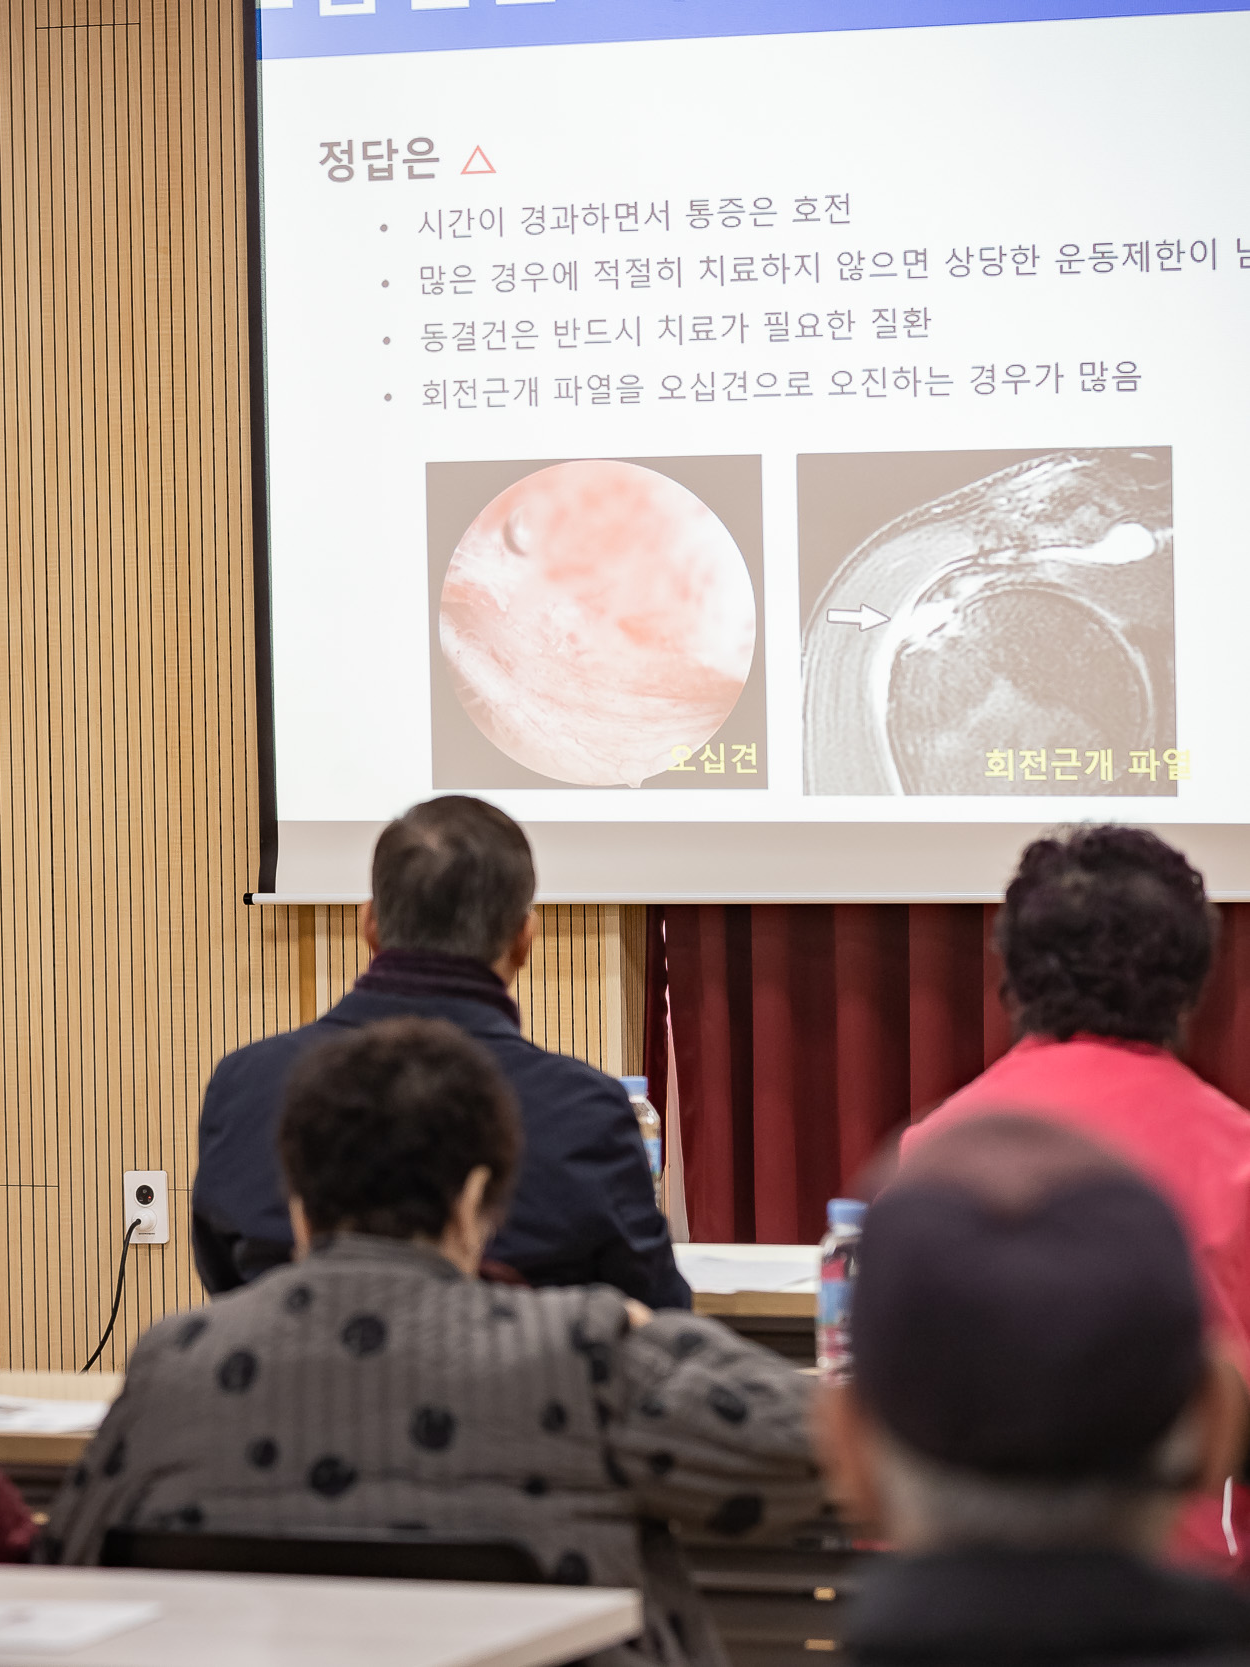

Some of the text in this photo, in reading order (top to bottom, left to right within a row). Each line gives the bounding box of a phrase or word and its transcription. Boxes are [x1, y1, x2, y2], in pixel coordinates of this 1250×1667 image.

[319, 137, 440, 183] 정답은
[418, 193, 850, 240] 시간이 경과하면서 통증은 호전
[420, 265, 476, 295] 많은
[492, 261, 577, 293] 경우에
[594, 257, 681, 290] 적절히
[700, 252, 819, 286] 치료하지
[837, 248, 928, 281] 않으면
[945, 244, 1040, 277] 상당한
[1055, 237, 1217, 274] 운동제한이
[421, 307, 932, 352] 동결건은 반드시 치료가 필요한 질환
[422, 361, 1141, 410] 회전근개 파열을 오십견으로 오진하는 경우가 많음
[667, 742, 758, 774] 오십견
[984, 746, 1191, 782] 회전근개 파열
